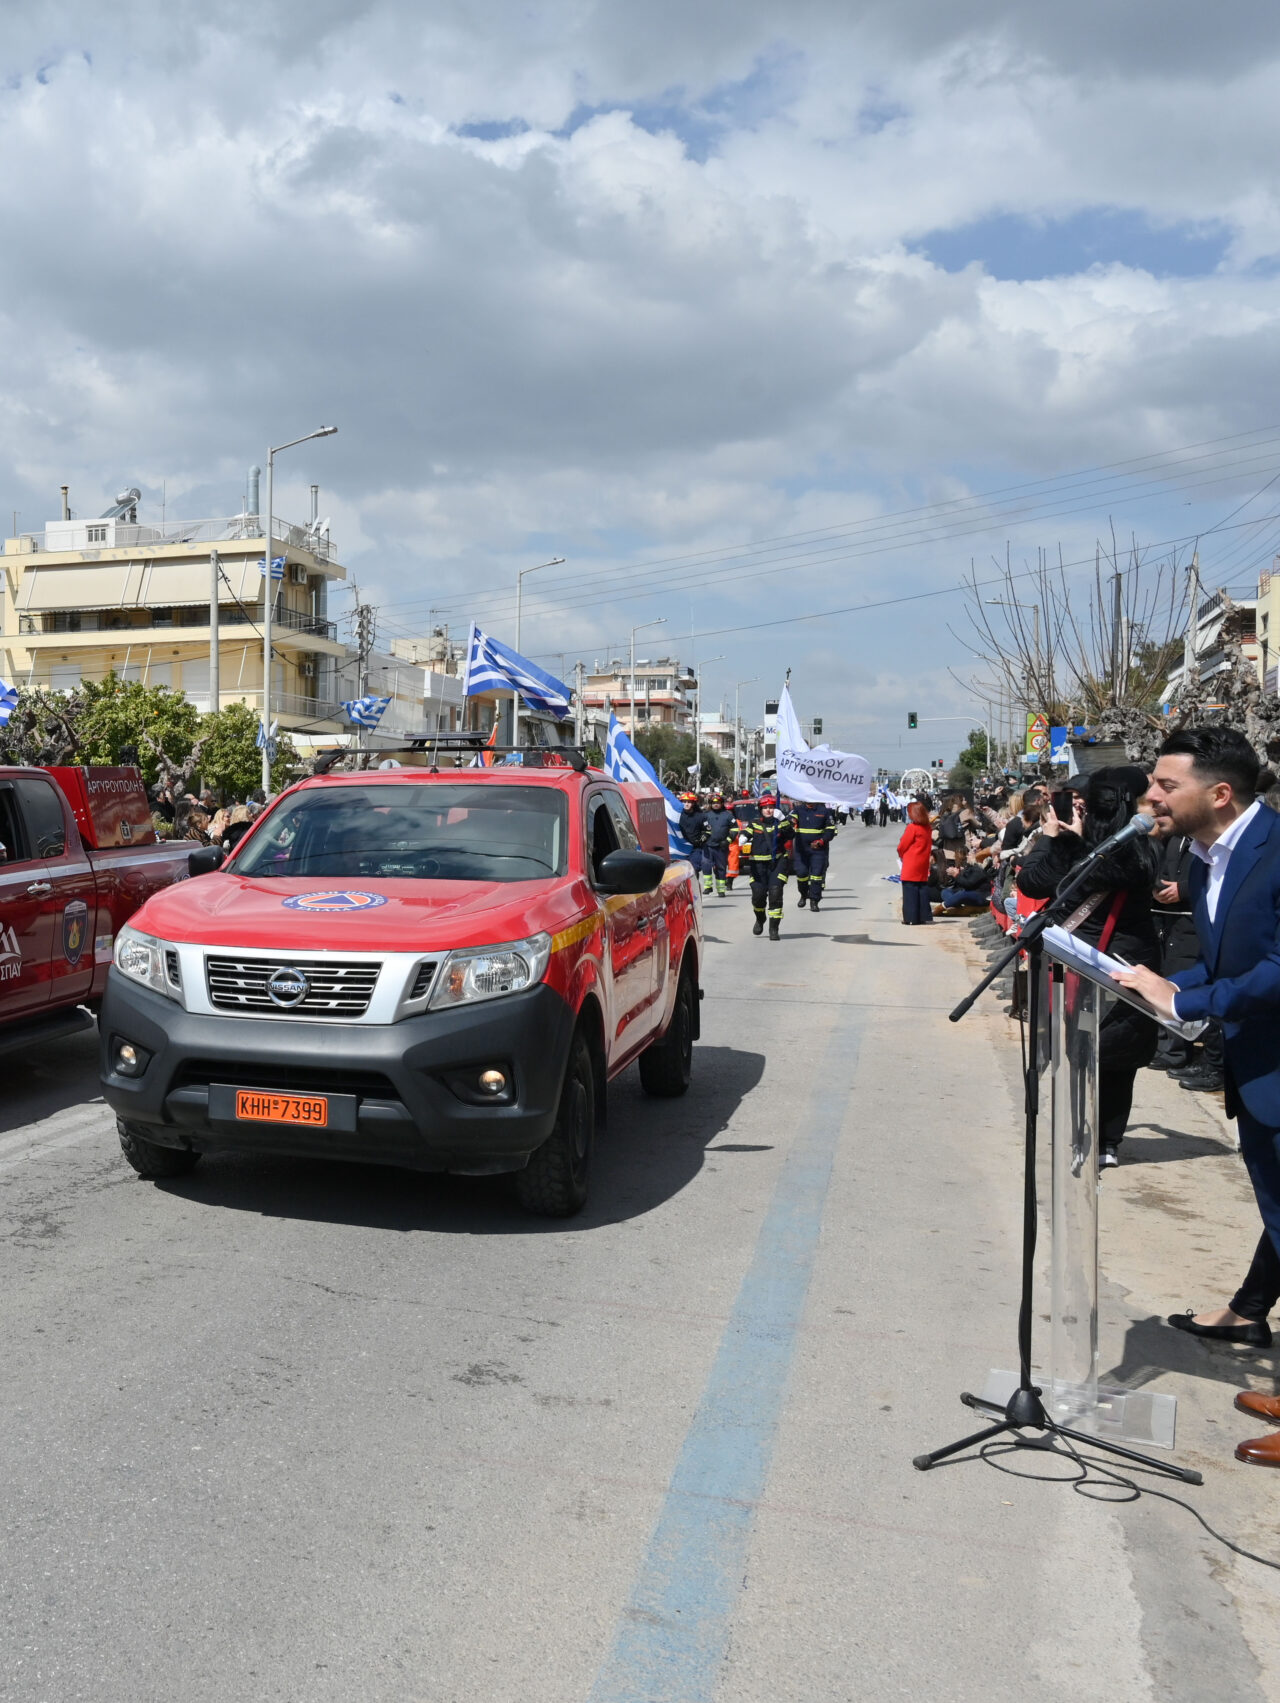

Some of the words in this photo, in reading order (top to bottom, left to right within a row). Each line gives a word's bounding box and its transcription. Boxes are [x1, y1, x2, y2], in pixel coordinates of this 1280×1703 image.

[780, 758, 864, 785] ΑΡΓΥΡΟΥΠΟΛΗΣ
[87, 780, 140, 793] ΑΡΓΥΡΟΥΠΟΛΗ
[0, 961, 22, 980] ΣΠΑΥ
[270, 984, 304, 992] NISSAN
